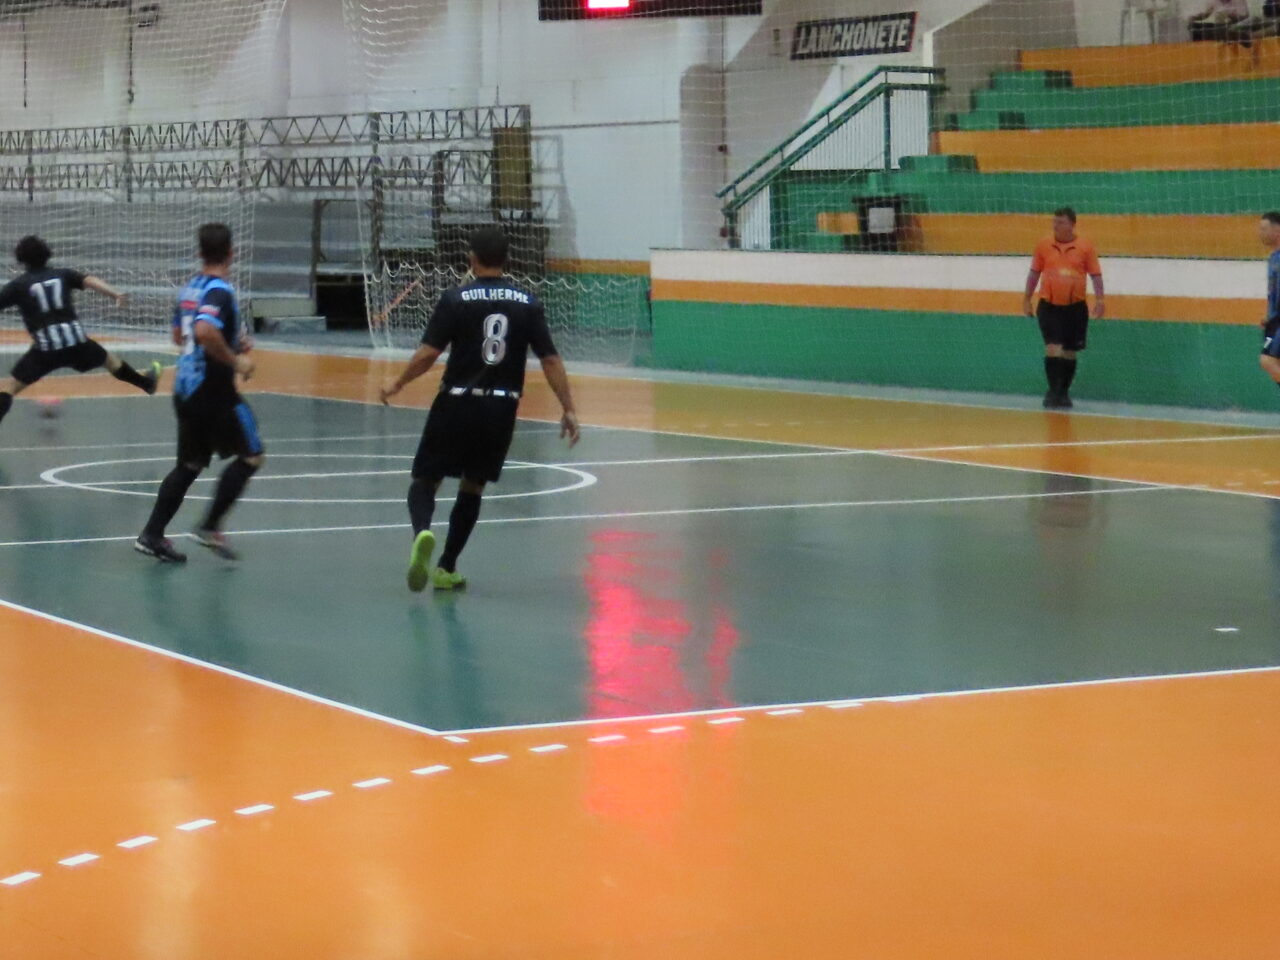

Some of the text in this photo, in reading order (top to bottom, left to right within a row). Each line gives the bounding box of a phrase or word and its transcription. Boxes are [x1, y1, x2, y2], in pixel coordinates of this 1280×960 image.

[796, 18, 911, 54] LANCHONETE
[29, 277, 63, 313] 17
[461, 287, 530, 304] GUILHERME
[481, 313, 509, 365] 8
